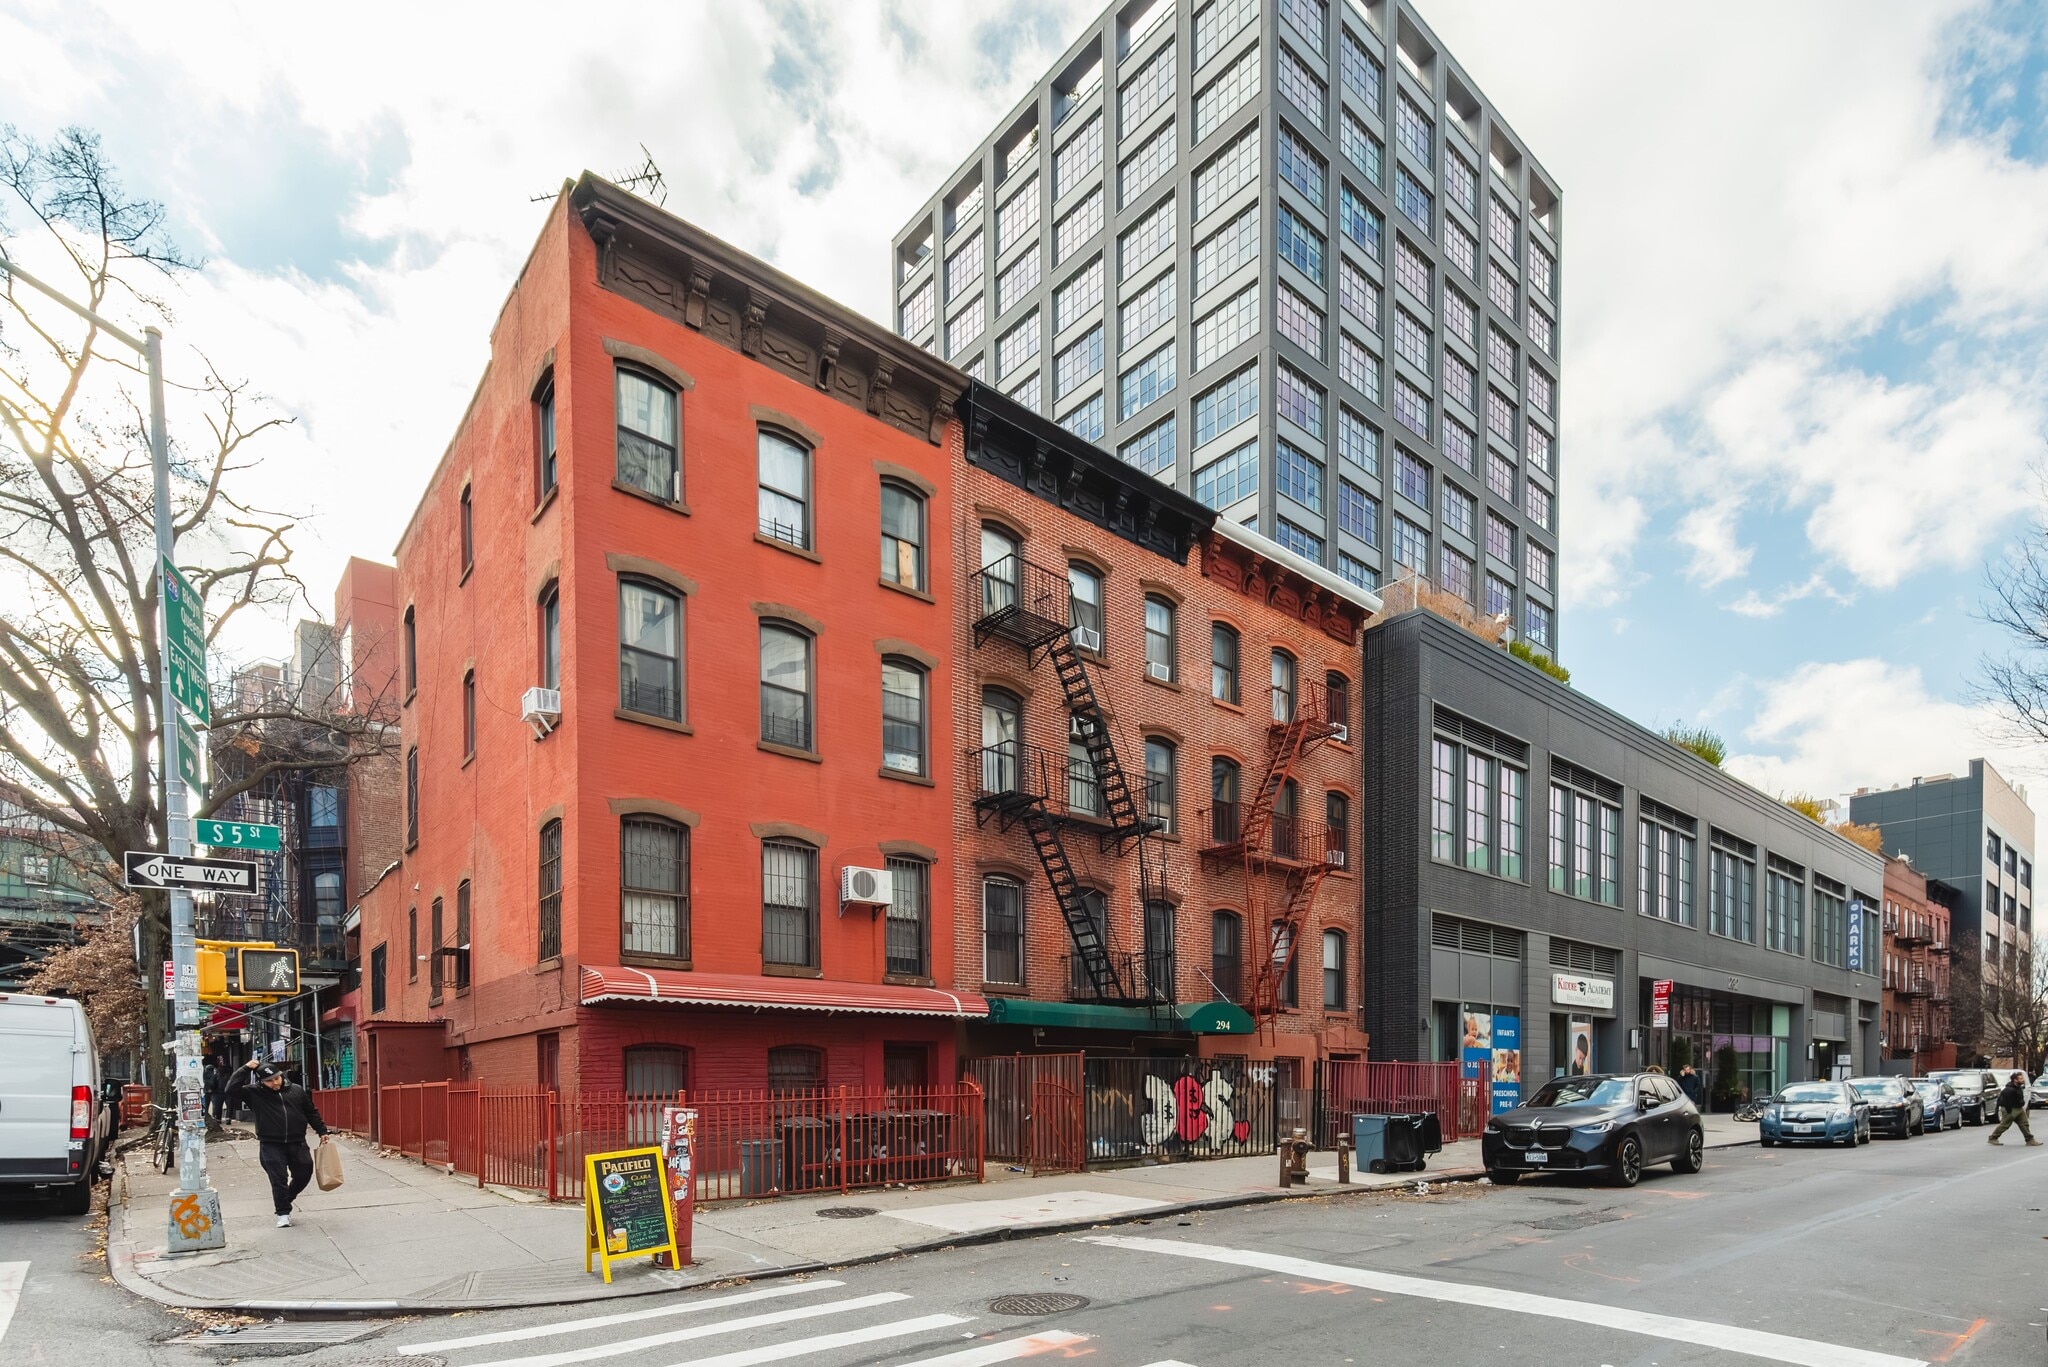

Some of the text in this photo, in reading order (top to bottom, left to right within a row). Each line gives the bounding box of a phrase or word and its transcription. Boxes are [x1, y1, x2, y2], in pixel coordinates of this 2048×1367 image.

[182, 587, 200, 620] Bklyn
[181, 607, 203, 643] Queens
[183, 630, 203, 666] Expwy
[170, 645, 186, 673] EAST
[190, 665, 206, 693] WEST
[213, 824, 261, 844] S 5 St
[147, 864, 241, 884] ONE WAY
[1849, 913, 1860, 957] PARK
[1587, 982, 1612, 996] ACADEMY
[1215, 1020, 1230, 1031] 294
[1496, 1029, 1515, 1038] INFANTS
[1493, 1089, 1519, 1098] PRESCHOOL
[1499, 1100, 1513, 1109] PRE-K
[601, 1158, 652, 1176] PACIFICO
